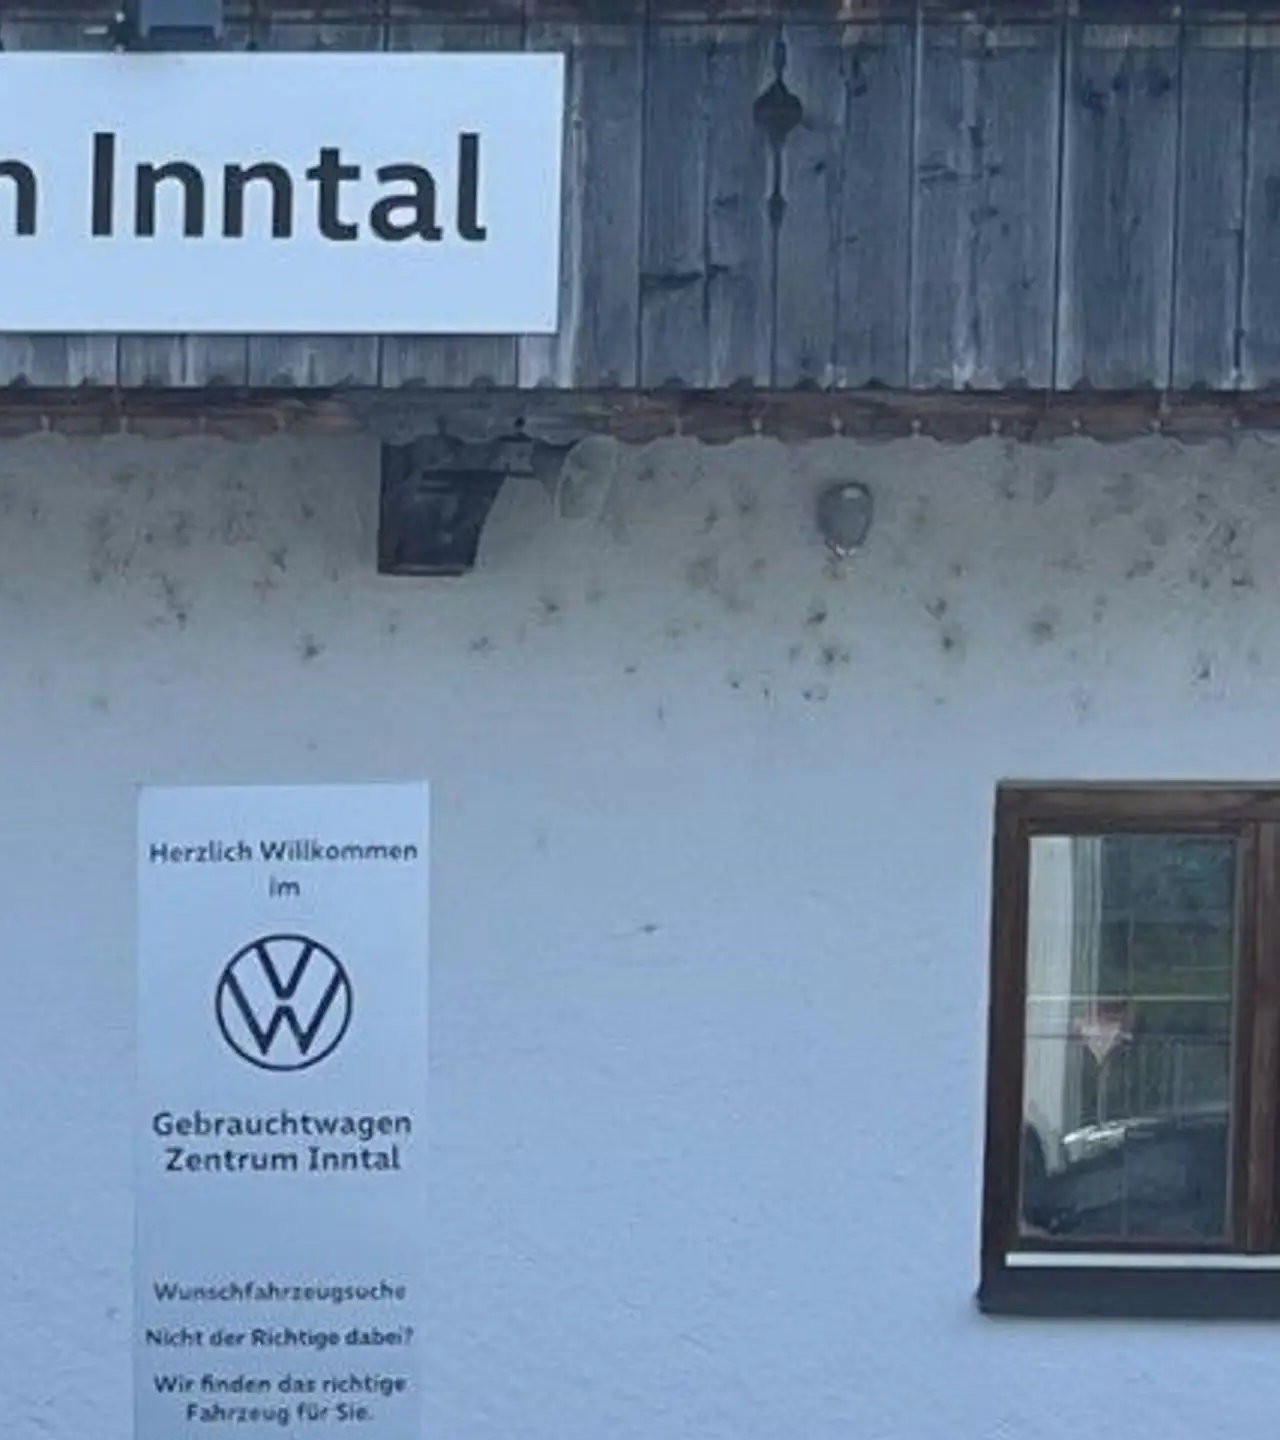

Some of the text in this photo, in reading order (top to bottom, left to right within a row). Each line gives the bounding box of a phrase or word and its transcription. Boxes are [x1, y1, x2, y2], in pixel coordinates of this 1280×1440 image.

[91, 131, 487, 242] Inntal
[149, 839, 418, 863] Herzlich Willkommen
[269, 877, 301, 897] im
[152, 1110, 412, 1141] Gebrauchtwagen
[165, 1145, 401, 1172] Zentrum Inntal
[153, 1280, 406, 1304] Wunschfahrzeugsuche
[145, 1326, 414, 1350] Nicht der Richtige dabei?
[153, 1373, 406, 1397] Wir finden das richtige
[186, 1402, 290, 1427] Fahrzeug
[296, 1401, 328, 1421] für
